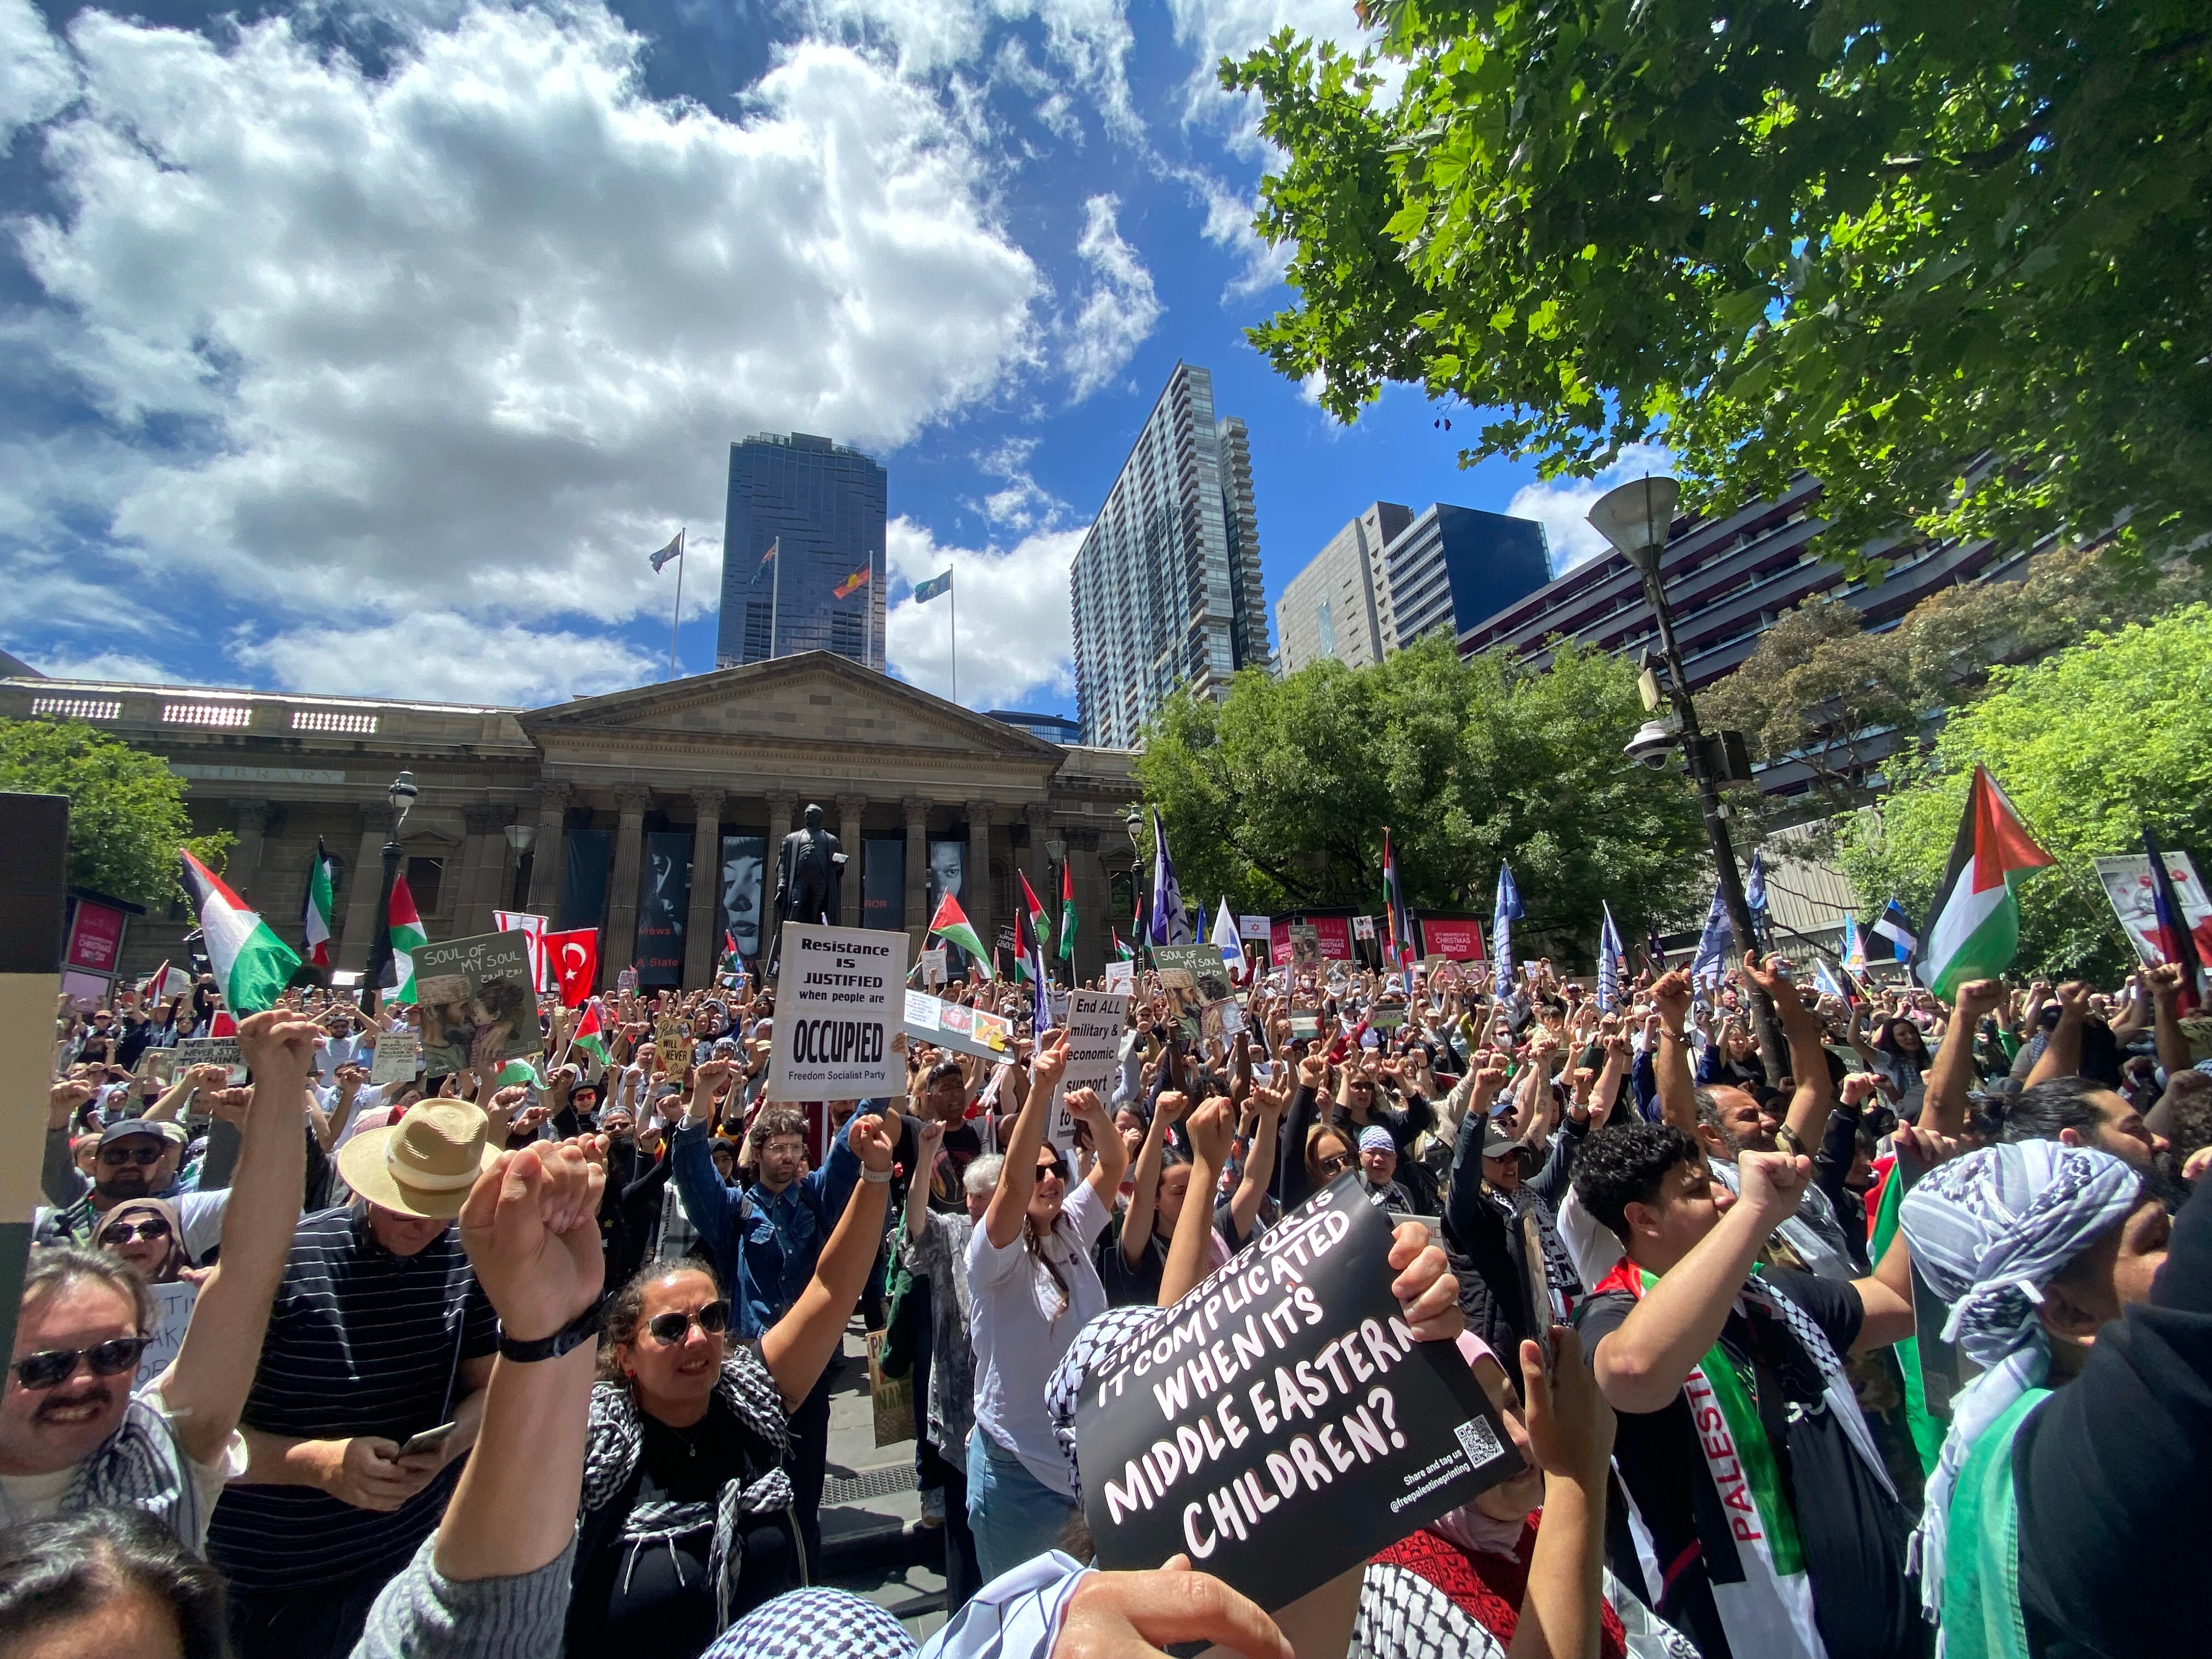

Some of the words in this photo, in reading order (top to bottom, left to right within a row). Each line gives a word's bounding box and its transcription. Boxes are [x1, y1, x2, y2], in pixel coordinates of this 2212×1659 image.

[754, 764, 879, 778] VICTORIA
[424, 947, 465, 966] SOUL
[469, 943, 487, 958] OF
[802, 938, 890, 956] Resistance
[460, 957, 483, 974] MY
[486, 951, 522, 968] SOUL
[637, 958, 645, 966] A
[650, 957, 680, 967] State
[836, 958, 855, 968] IS
[1160, 950, 1185, 961] SOUL
[1186, 950, 1197, 958] OF
[1183, 960, 1198, 969] MY
[1198, 957, 1220, 968] SOUL
[480, 968, 504, 984] الروح
[506, 968, 523, 978] روح
[803, 972, 883, 988] JUSTIFIED
[799, 990, 827, 1001] when
[832, 991, 865, 1003] people
[869, 995, 884, 1003] are
[1076, 998, 1098, 1013] End
[1098, 1000, 1120, 1014] ALL
[1070, 1023, 1109, 1040] military
[1111, 1024, 1119, 1036] &
[184, 1040, 205, 1048] WE
[663, 1039, 678, 1048] WILL
[793, 1019, 883, 1063] OCCUPIED
[179, 1055, 241, 1066] TEACHING
[184, 1048, 214, 1057] NEVER
[665, 1049, 687, 1062] NEVER
[1067, 1046, 1114, 1060] economic
[669, 1063, 684, 1076] Die
[1843, 1058, 1859, 1066] OUL
[788, 1071, 825, 1080] Freedom
[827, 1070, 862, 1080] Socialist
[865, 1070, 885, 1080] Party
[1059, 1107, 1070, 1126] to
[1305, 1189, 1334, 1215] IS
[165, 1295, 195, 1314] TI
[1098, 1364, 1130, 1408] IT
[1133, 1210, 1350, 1377] COMPLICATED
[870, 1334, 885, 1359] PA
[1153, 1314, 1265, 1421] WHEN
[1104, 1393, 1249, 1525] MIDDLE
[1248, 1315, 1415, 1434] EASTERN
[1183, 1387, 1406, 1559] CHILDREN?
[1403, 1469, 1426, 1486] Share
[1425, 1459, 1441, 1474] and
[1439, 1453, 1454, 1468] tag
[1452, 1448, 1463, 1458] us
[1390, 1462, 1471, 1513] @freepalestineprinting
